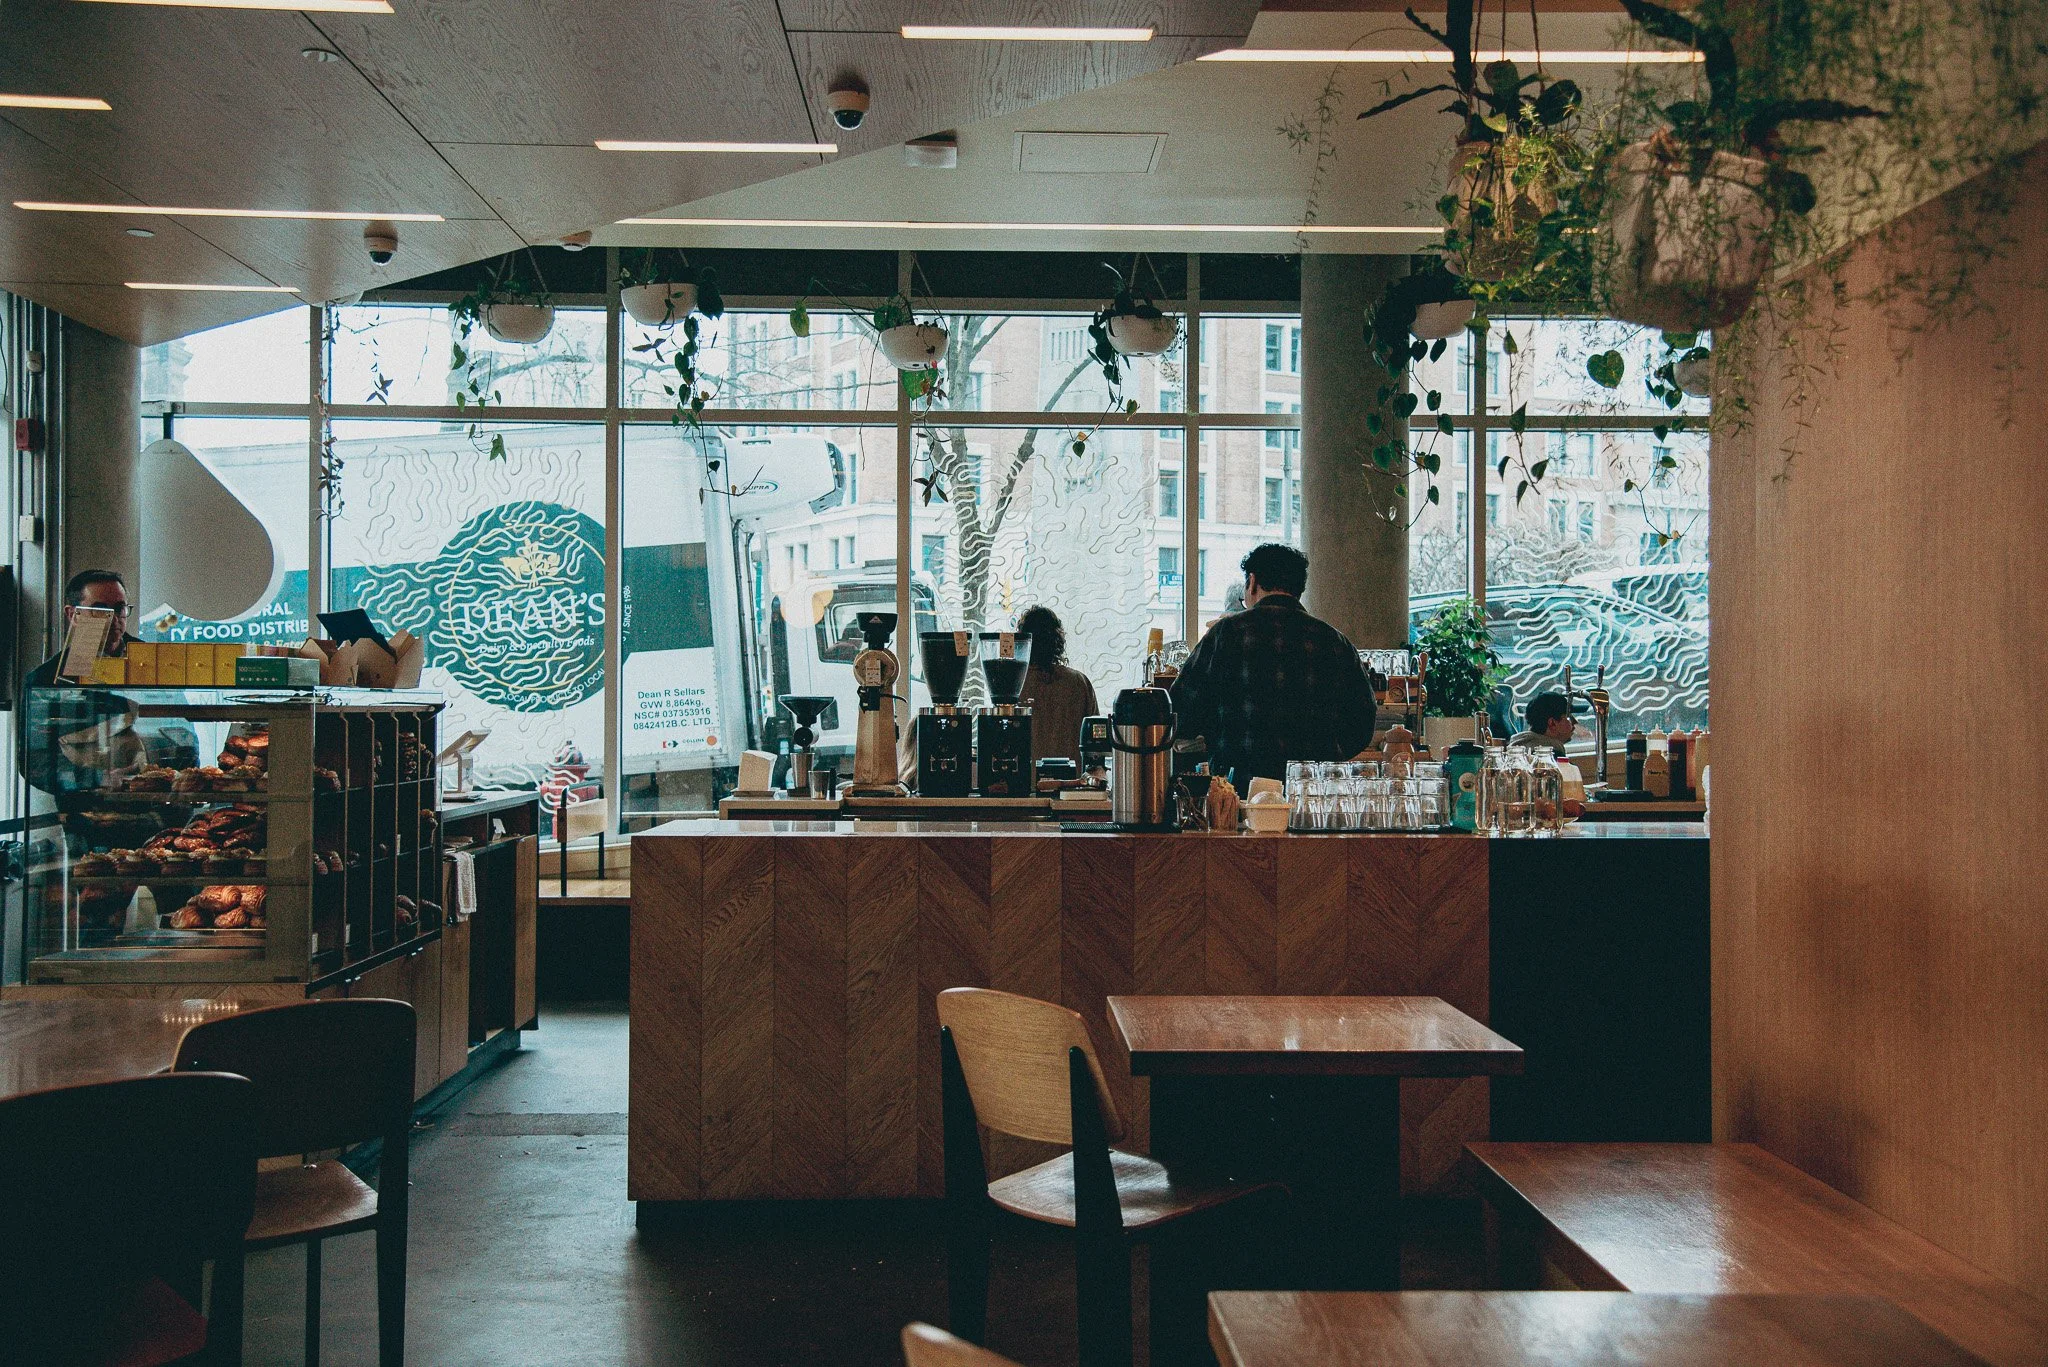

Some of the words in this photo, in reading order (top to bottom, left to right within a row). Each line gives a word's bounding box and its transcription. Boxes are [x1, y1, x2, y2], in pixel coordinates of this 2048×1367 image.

[623, 585, 632, 602] 1986
[463, 592, 605, 634] DEAN'S
[623, 604, 632, 628] SINCE
[193, 624, 243, 640] FOOD
[479, 642, 507, 654] Dairy
[567, 636, 595, 648] Foods
[638, 691, 661, 699] Dean
[664, 689, 671, 697] R
[674, 688, 705, 696] Sellars
[640, 700, 662, 709] GVW
[634, 711, 660, 720] NSC#
[662, 707, 711, 718] 037353916
[693, 717, 714, 726] LTD.
